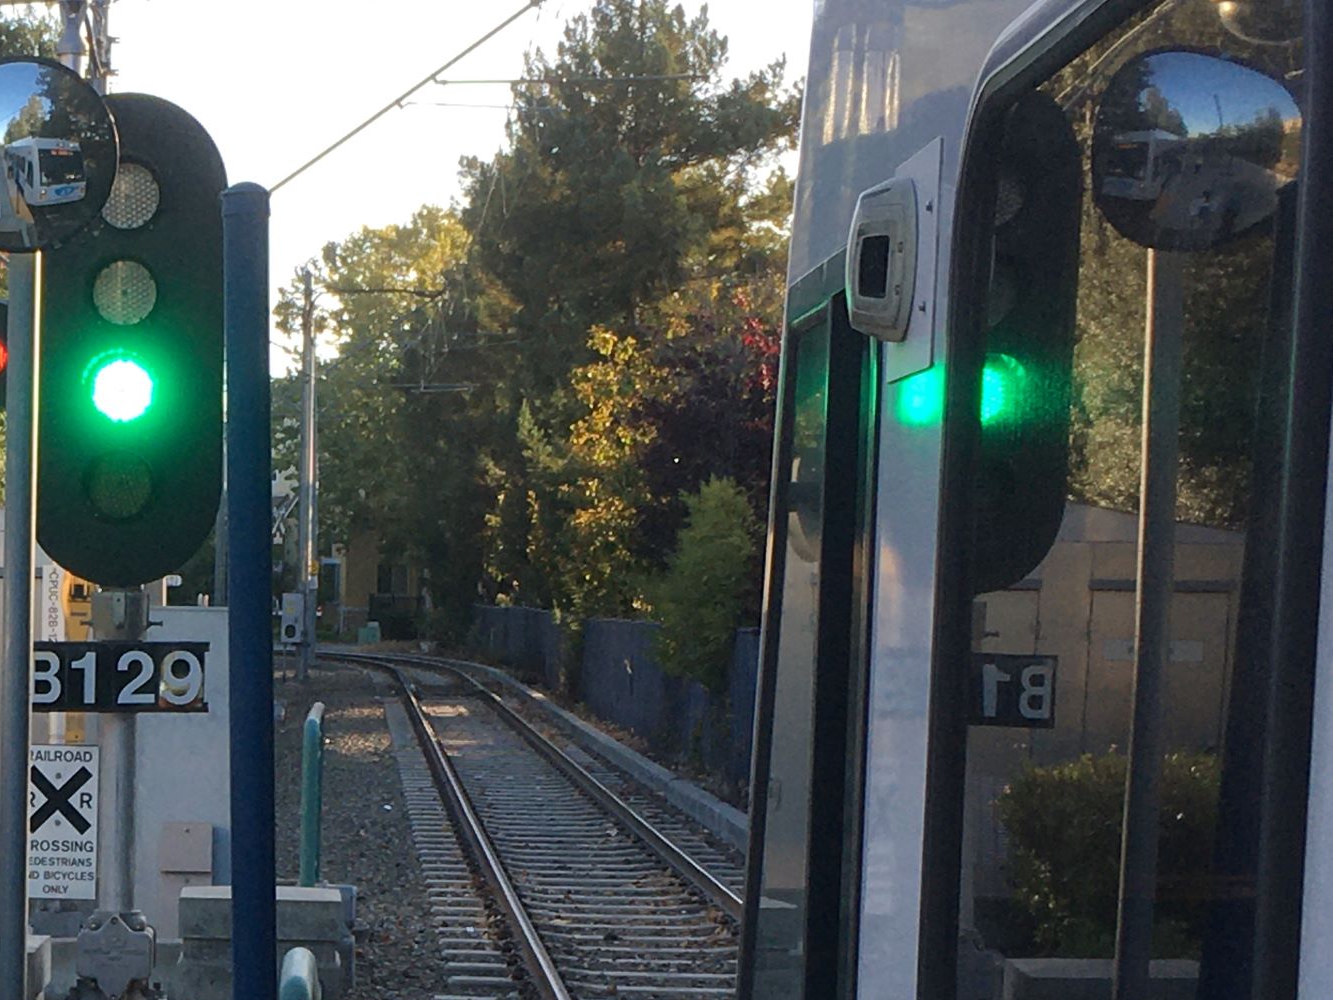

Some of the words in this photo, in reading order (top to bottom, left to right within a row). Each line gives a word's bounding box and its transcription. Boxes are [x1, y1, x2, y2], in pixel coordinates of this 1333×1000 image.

[32, 650, 203, 705] B129
[43, 871, 94, 881] BICYCLES
[42, 885, 69, 894] ONLY
